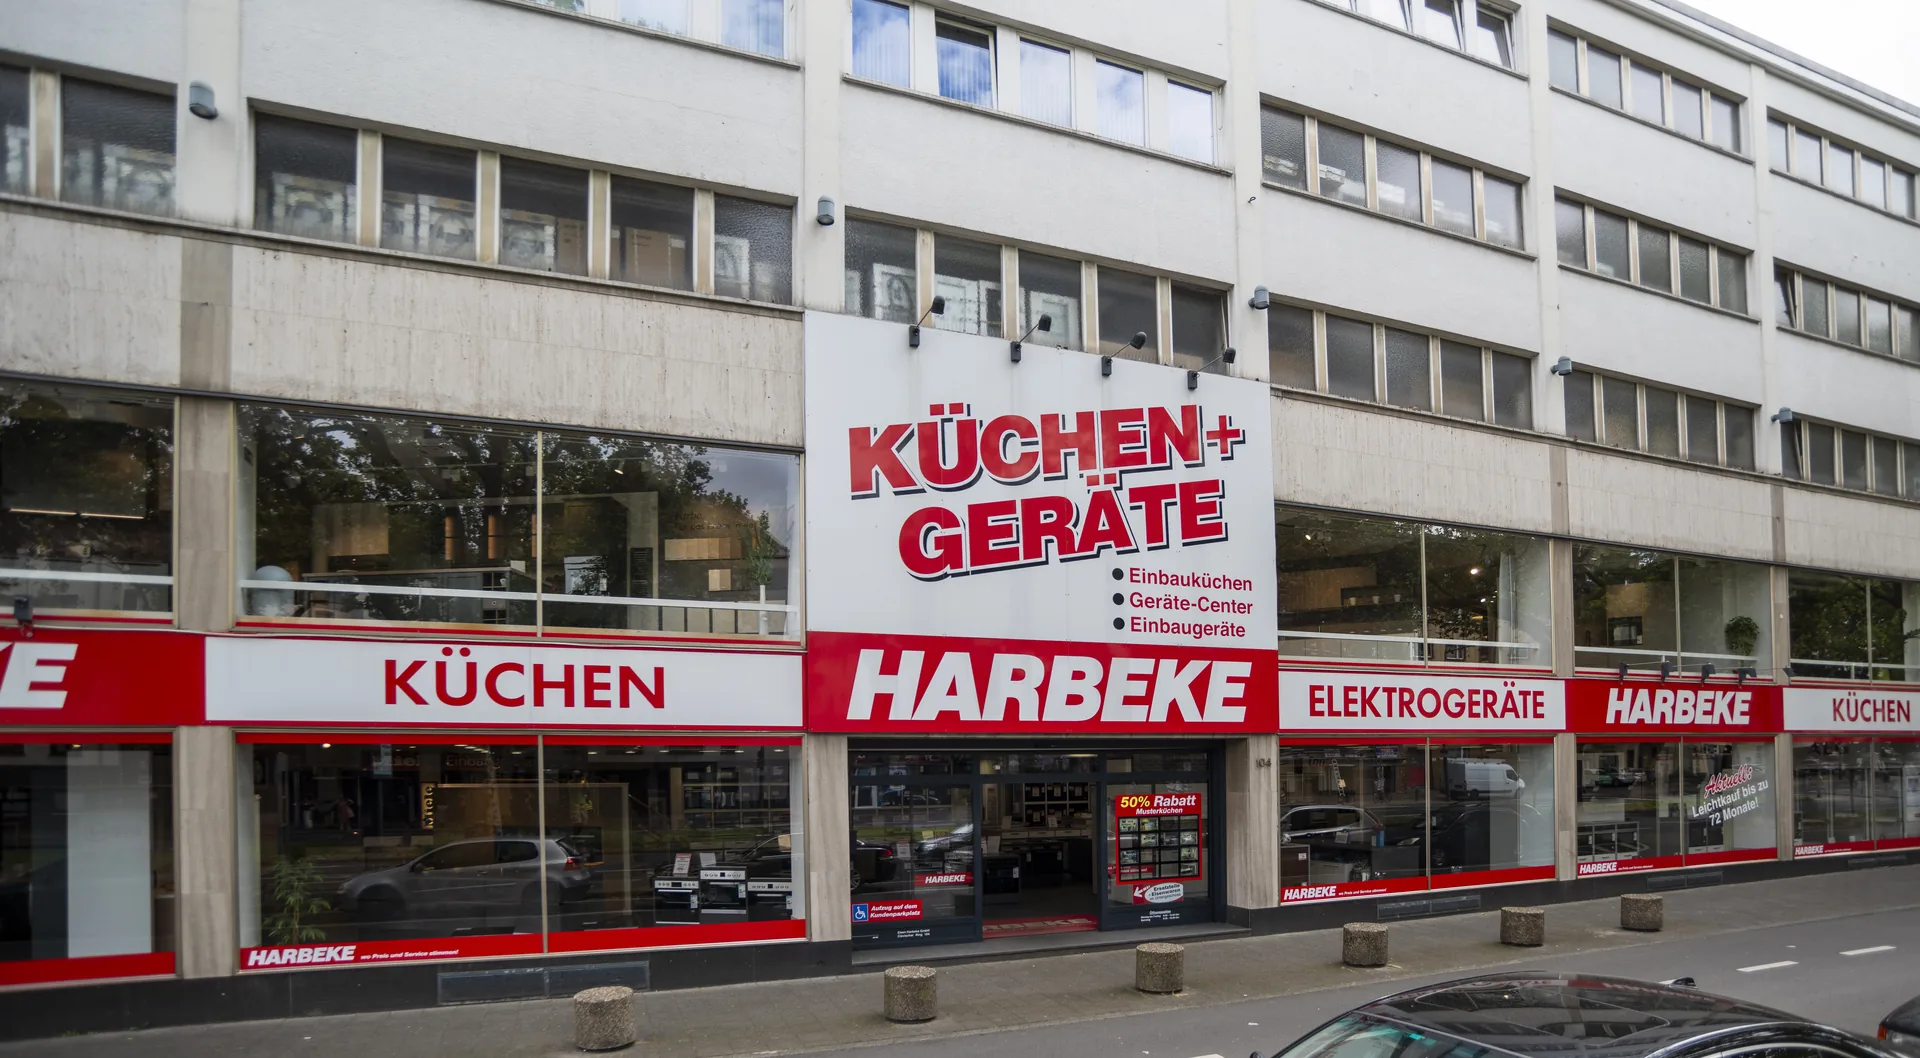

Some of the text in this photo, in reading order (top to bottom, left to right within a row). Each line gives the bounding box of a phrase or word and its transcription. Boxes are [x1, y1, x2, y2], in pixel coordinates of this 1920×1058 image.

[849, 402, 1245, 499] KÜCHEN+
[899, 473, 1227, 581] GERÄTE
[1129, 568, 1253, 592] Einbauküchen
[1129, 592, 1253, 614] Geräte-Center
[1130, 617, 1246, 639] Einbaugeräte
[385, 647, 665, 709] KÜCHEN
[846, 649, 1253, 723] HARBEKE
[1309, 681, 1545, 719] ELEKTROGERÄTE
[1606, 688, 1752, 725] HARBEKE
[1832, 691, 1910, 723] KÜCHEN
[1255, 757, 1272, 768] 104
[1704, 763, 1753, 799] Aktuell:
[424, 785, 434, 829] Miele
[1121, 795, 1196, 808] 50% Rabatt
[1692, 780, 1769, 818] Leichtkauf bis zu
[1709, 797, 1759, 826] 72 Monate!
[1795, 845, 1824, 856] HARBEKE
[925, 874, 966, 884] HARBEKE
[1579, 862, 1618, 874] HARBEKE
[1283, 886, 1337, 900] HARBEKE
[870, 910, 921, 918] Kundenparkplatz
[248, 945, 356, 966] HARBEKE
